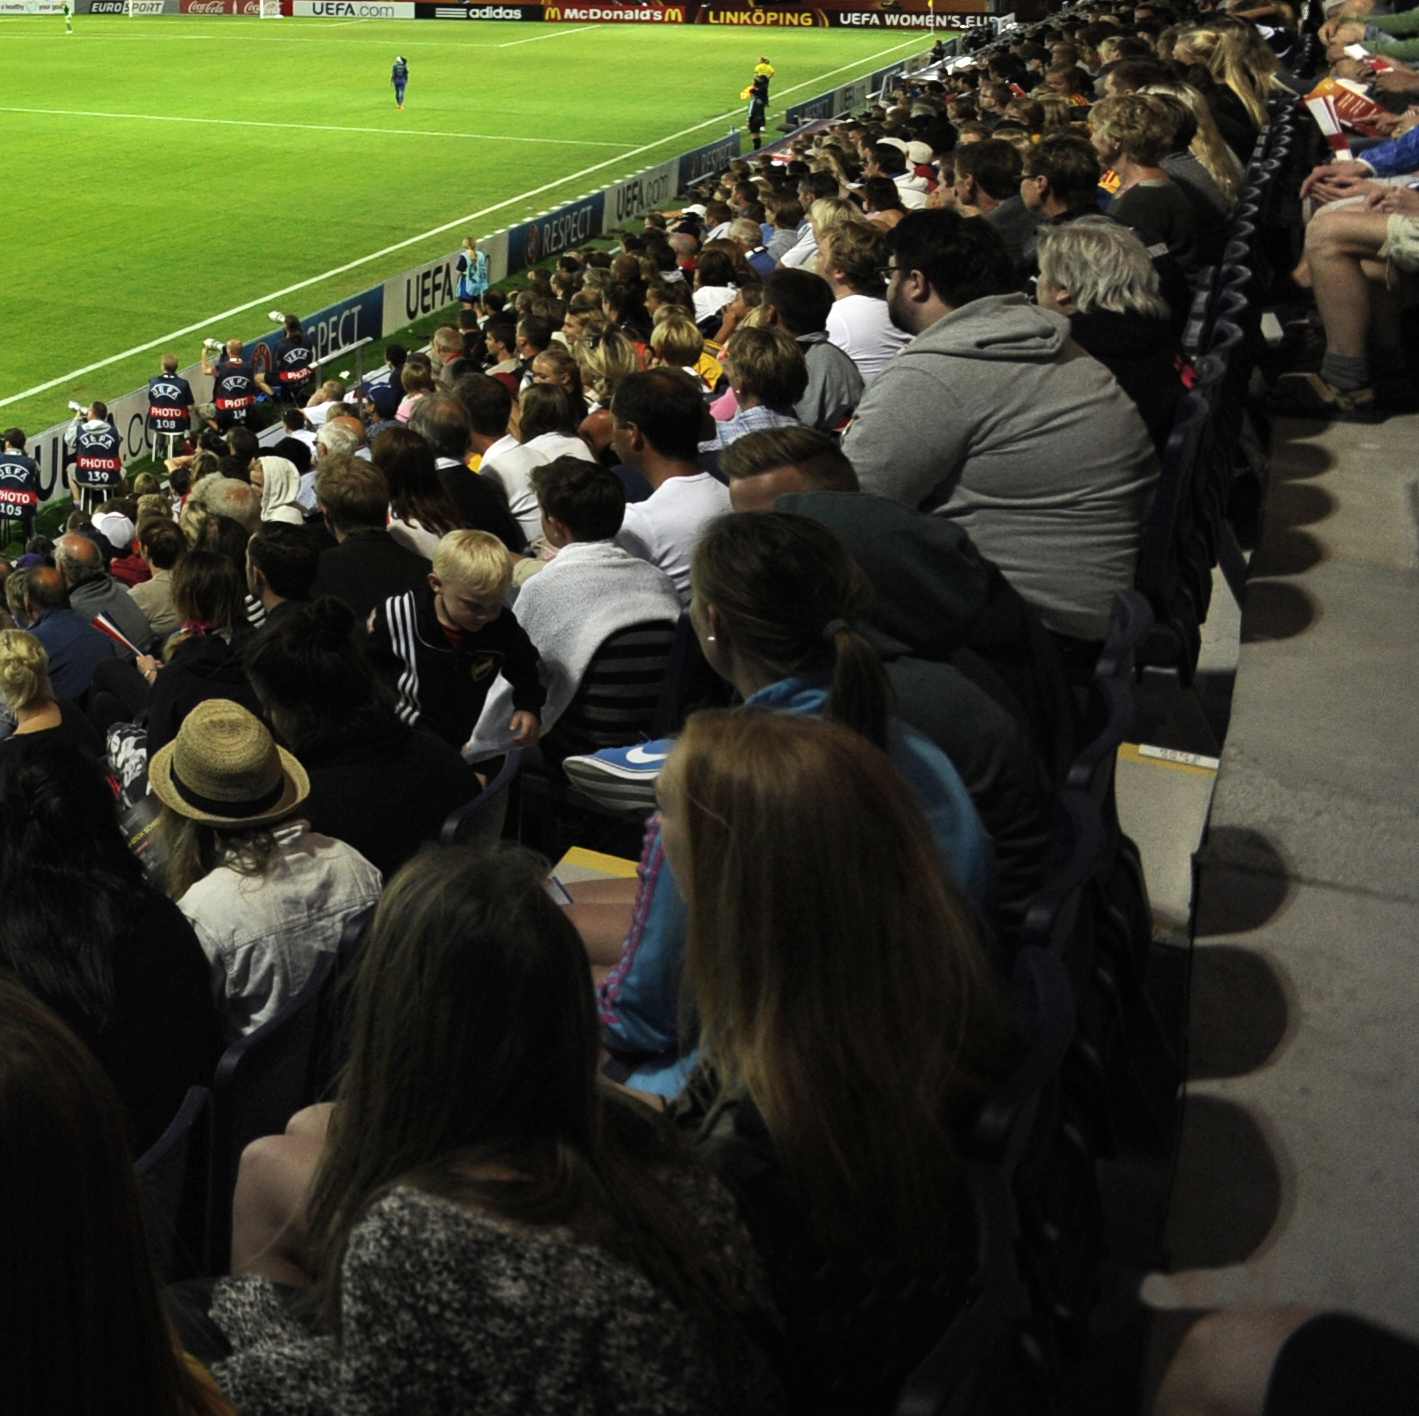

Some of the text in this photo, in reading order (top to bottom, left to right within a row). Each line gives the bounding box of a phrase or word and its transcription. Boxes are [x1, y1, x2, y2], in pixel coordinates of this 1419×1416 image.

[313, 2, 394, 17] UEFA.com
[469, 6, 522, 19] adidas
[564, 8, 663, 20] McDonald's
[709, 9, 812, 25] LINKÖPING
[839, 12, 880, 25] UEFA
[884, 13, 961, 27] WOMEN'S
[542, 205, 593, 256] RESPECT
[151, 385, 181, 401] UEFA
[151, 407, 181, 417] PHOTO
[156, 419, 176, 429] 108
[81, 434, 113, 449] UEFA
[80, 458, 114, 469] PHOTO
[87, 471, 109, 482] 139
[0, 503, 22, 516] 105
